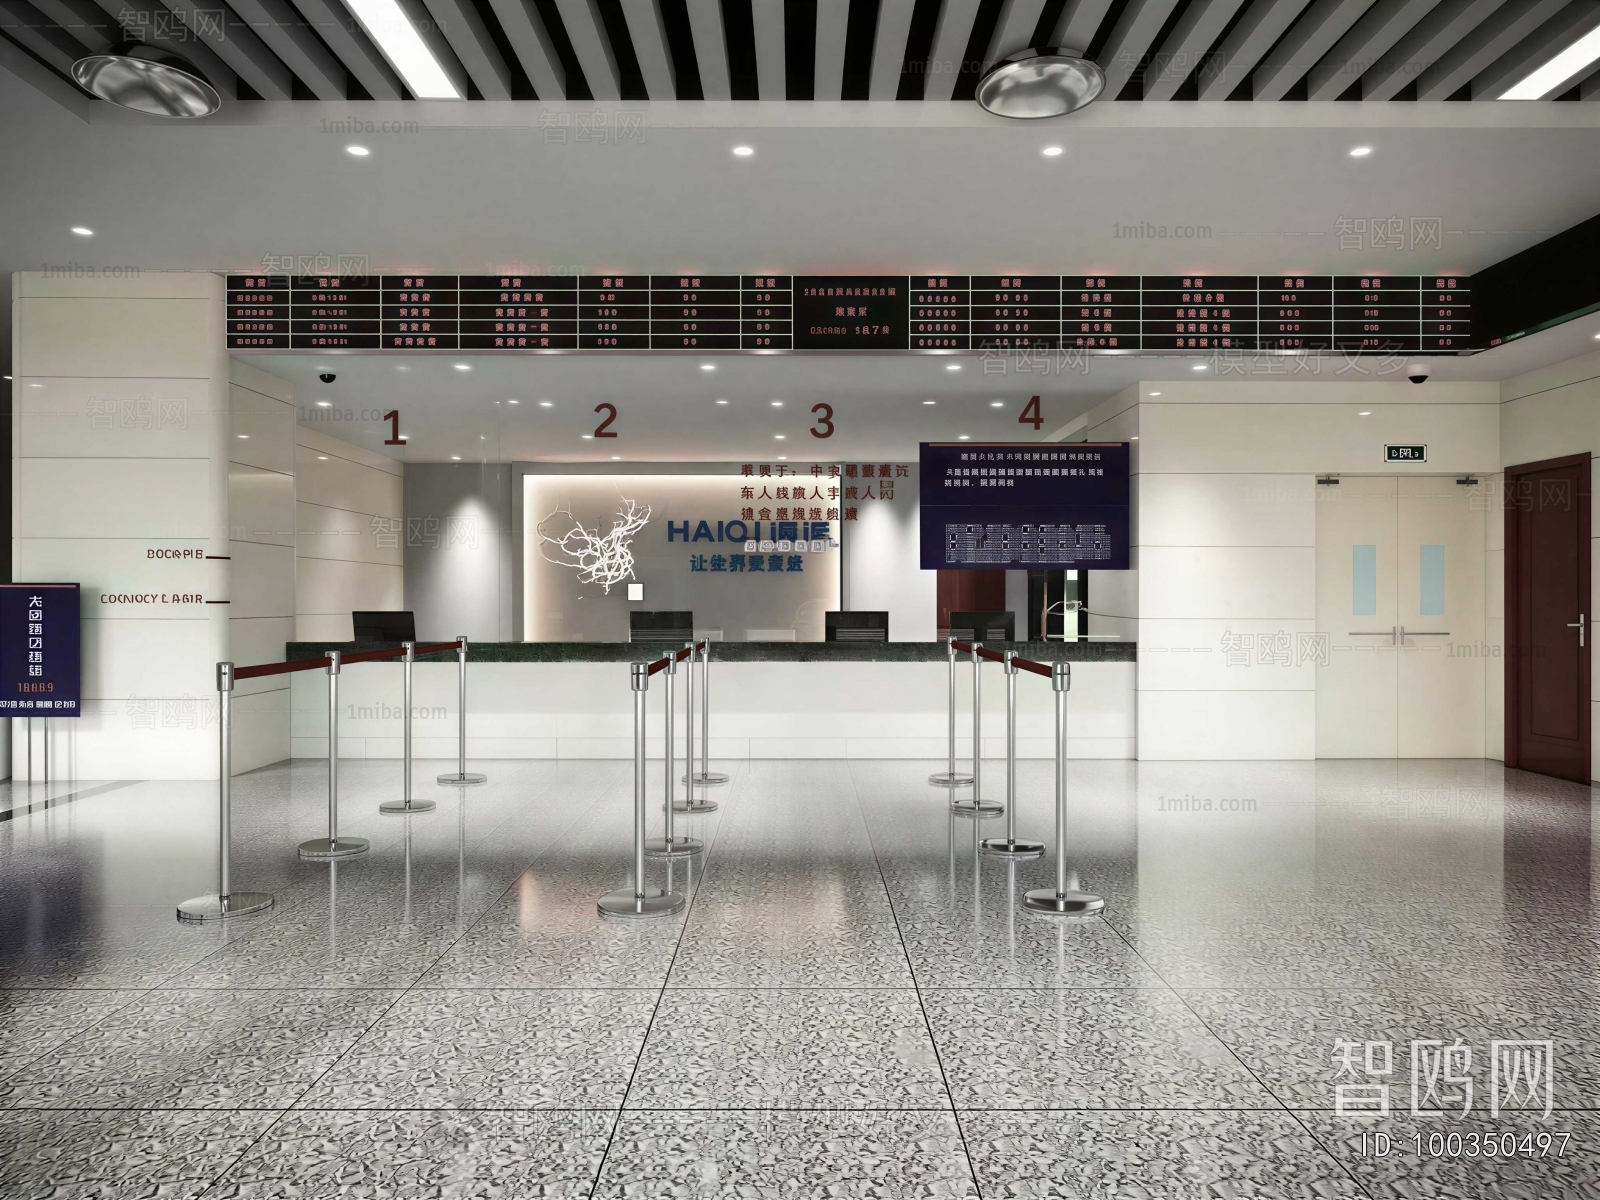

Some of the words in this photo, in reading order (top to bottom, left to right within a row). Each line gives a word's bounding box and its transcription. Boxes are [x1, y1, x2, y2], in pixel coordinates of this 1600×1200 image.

[384, 409, 406, 445] 1
[594, 402, 617, 438] 2
[810, 403, 834, 439] 3
[1018, 396, 1044, 430] 4
